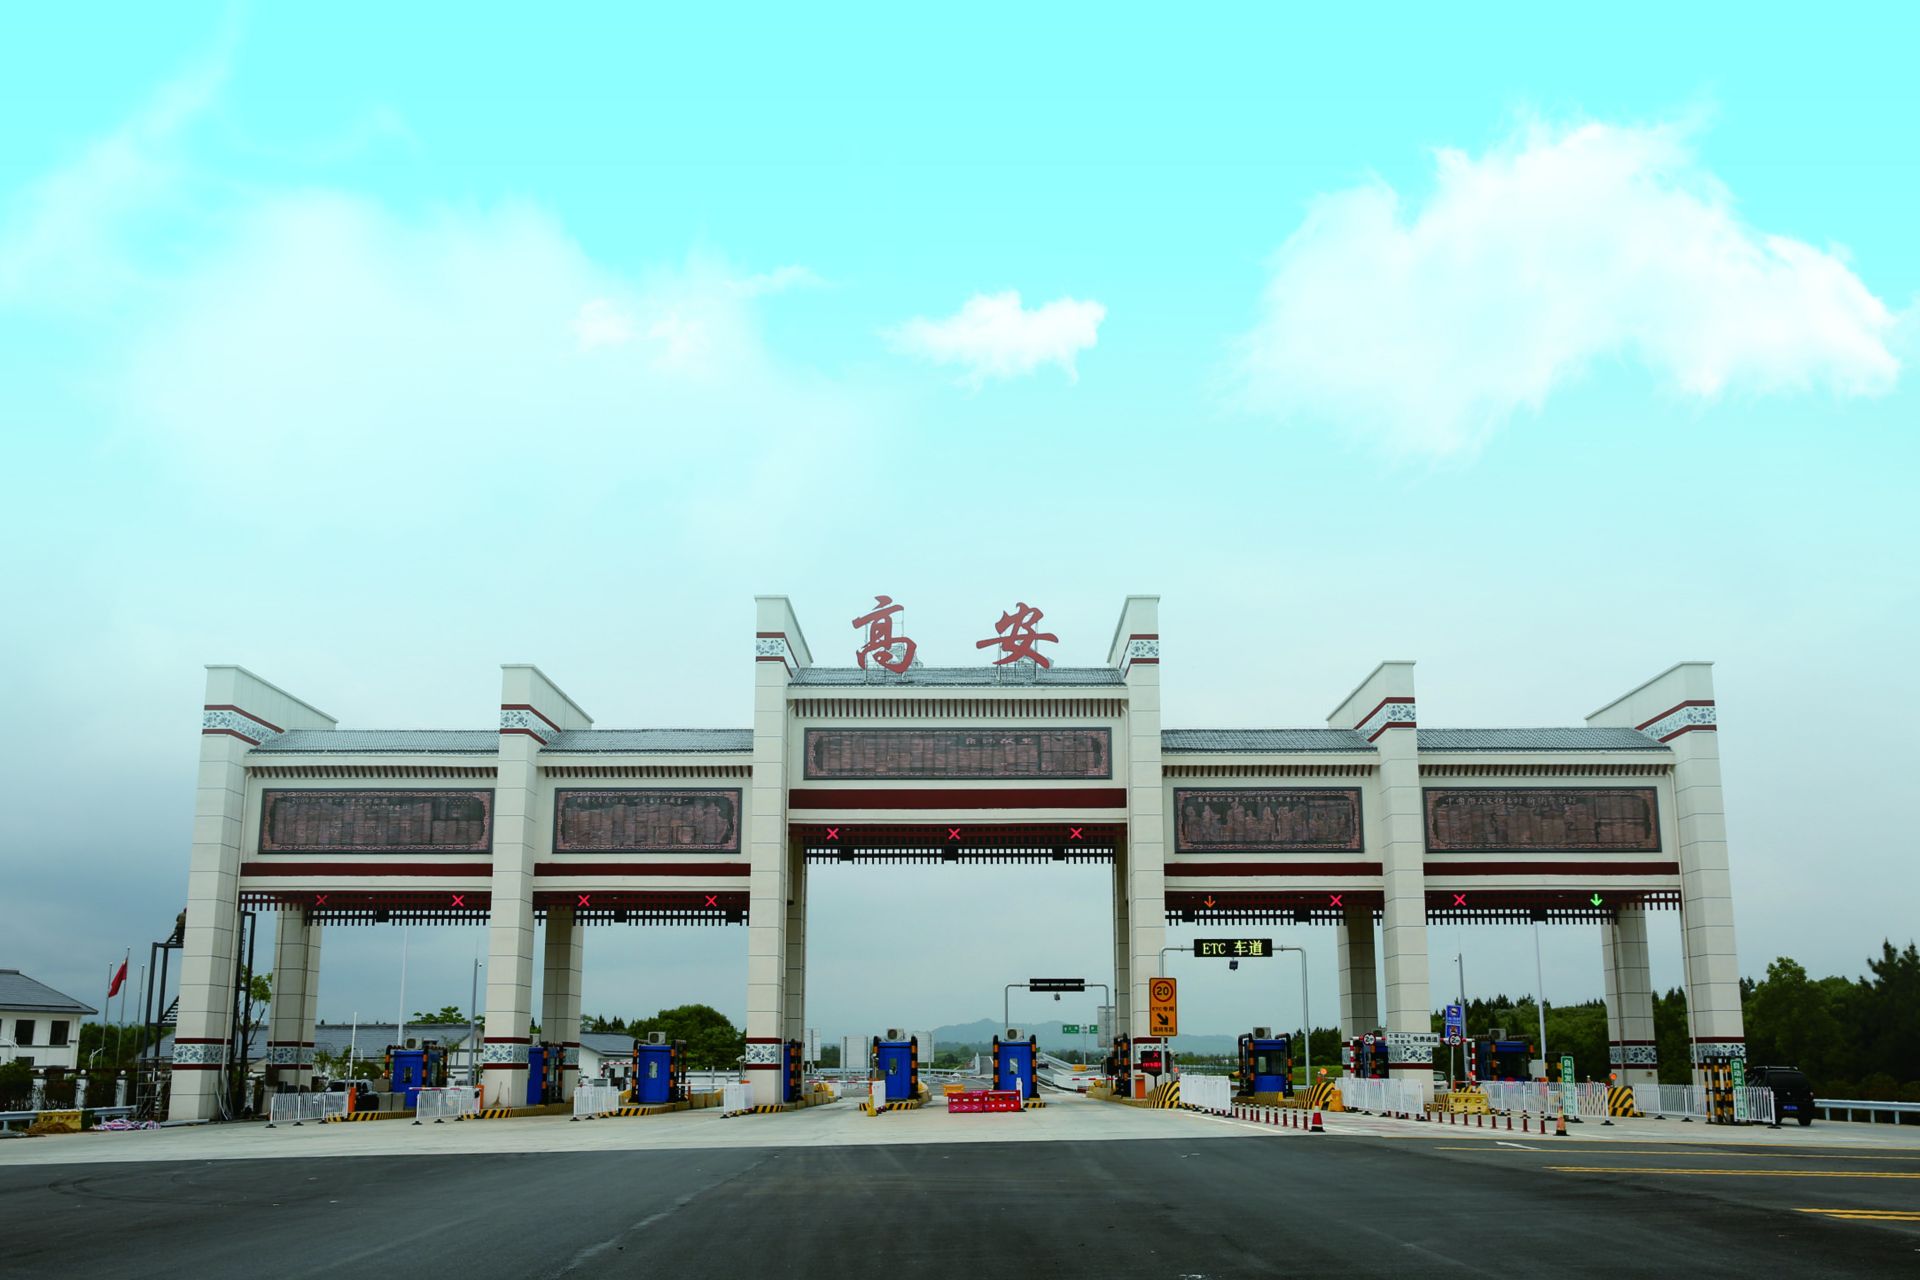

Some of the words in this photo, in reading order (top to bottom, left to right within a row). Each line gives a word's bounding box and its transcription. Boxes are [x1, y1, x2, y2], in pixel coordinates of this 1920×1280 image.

[852, 595, 1059, 673] 高安
[1202, 943, 1226, 954] ETC
[1234, 940, 1263, 956] 车道
[1156, 986, 1169, 996] 20
